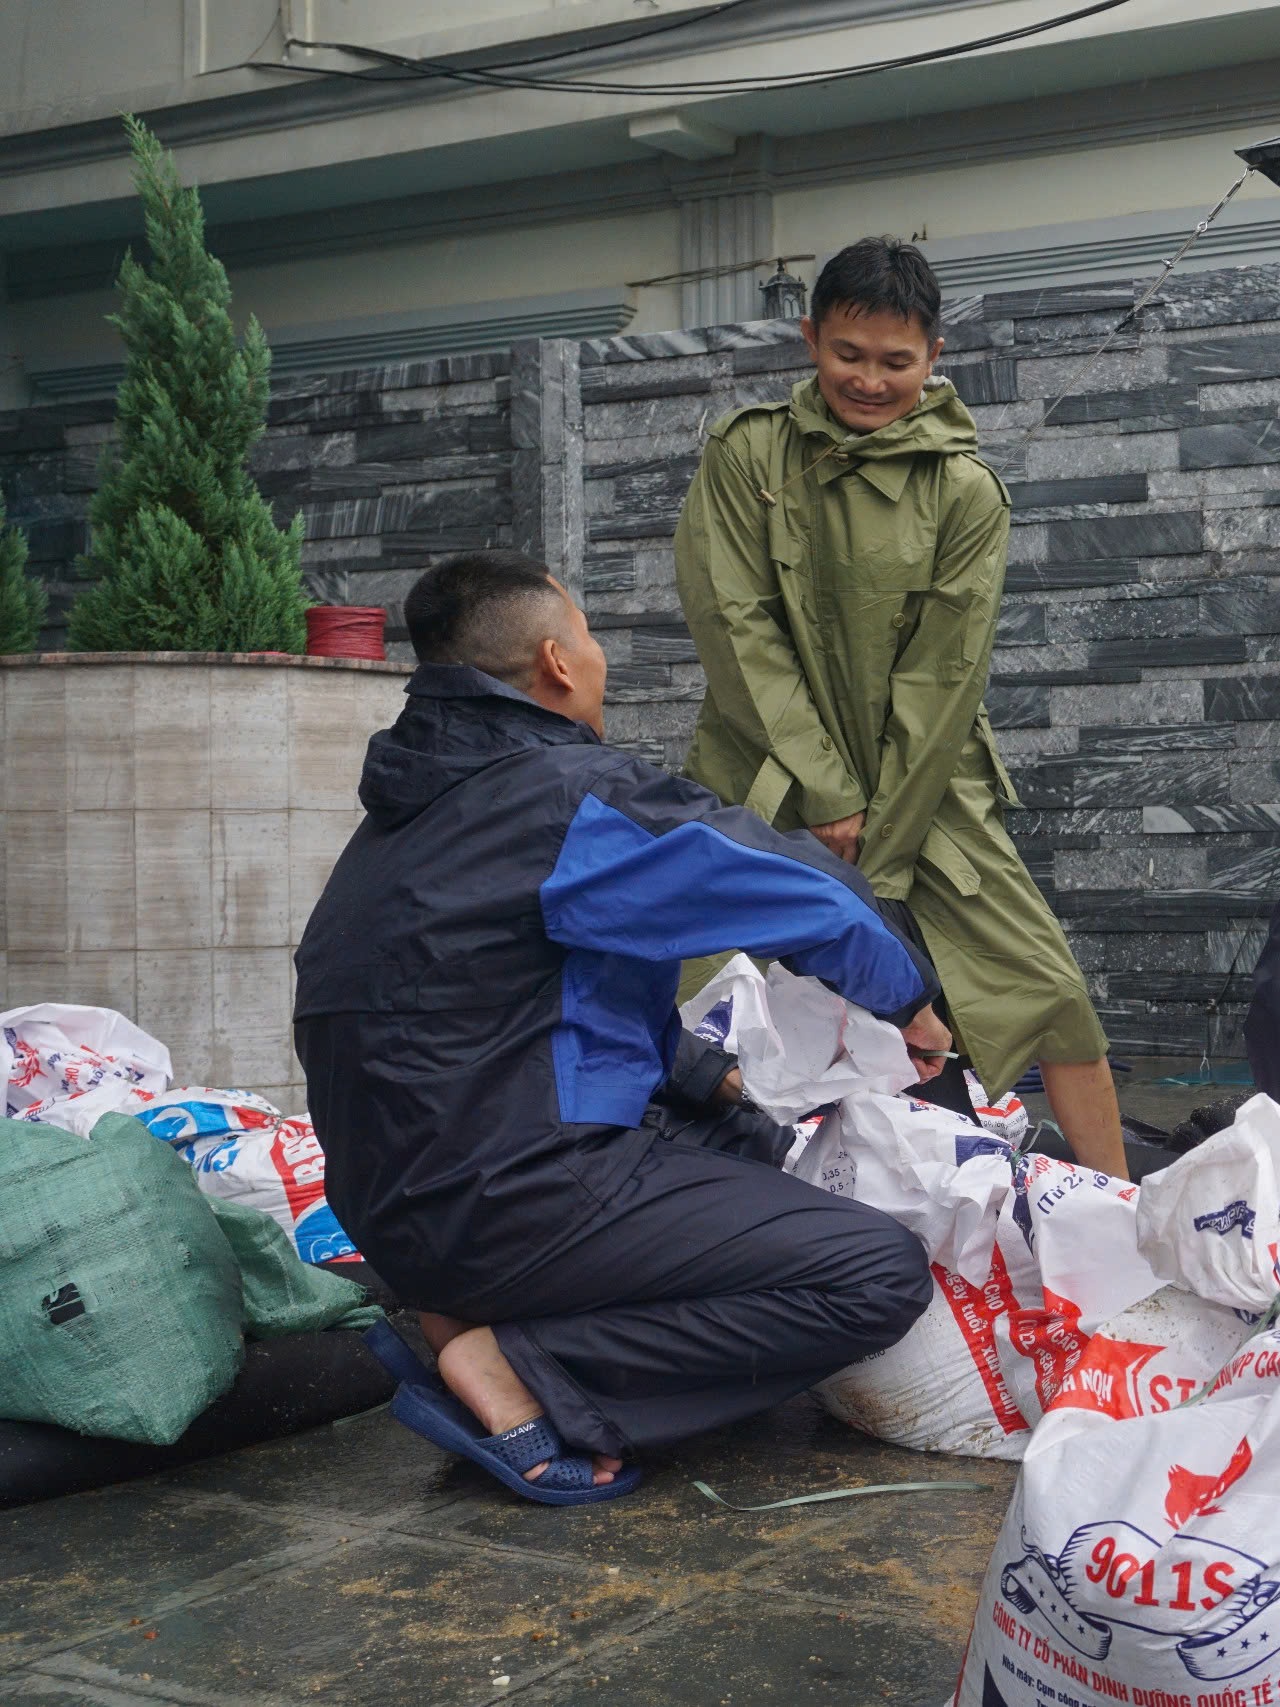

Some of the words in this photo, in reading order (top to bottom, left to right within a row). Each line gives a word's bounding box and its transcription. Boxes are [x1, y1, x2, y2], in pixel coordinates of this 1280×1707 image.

[961, 1302, 988, 1335] tuổi
[983, 1284, 1005, 1311] CHO
[1084, 1536, 1236, 1612] 9011S
[992, 1600, 1016, 1641] CÔNG
[1017, 1624, 1032, 1652] TY
[1033, 1636, 1050, 1665] CỔ
[1053, 1651, 1090, 1686] PHẦN
[1091, 1670, 1129, 1704] DINH
[1251, 1674, 1275, 1707] TẾ
